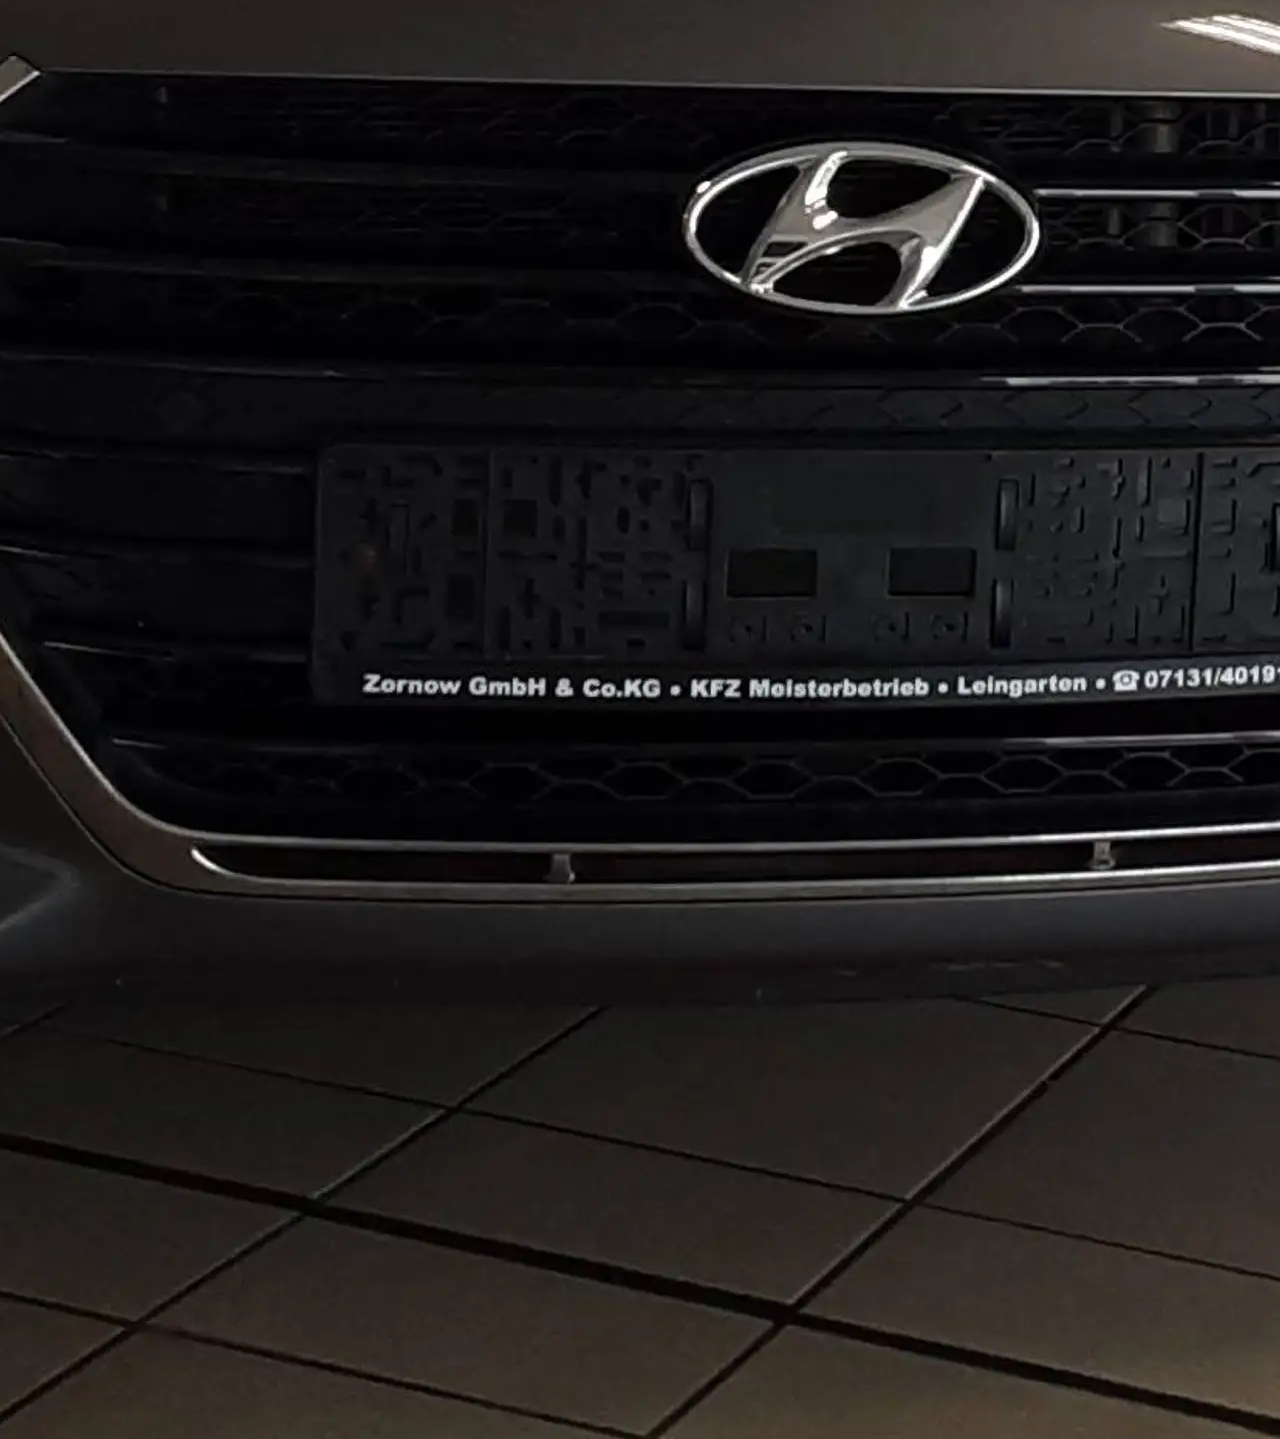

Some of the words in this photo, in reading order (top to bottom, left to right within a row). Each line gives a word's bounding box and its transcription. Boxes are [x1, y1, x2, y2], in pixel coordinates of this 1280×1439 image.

[361, 672, 463, 696] Zornow
[467, 675, 548, 698] GmbH
[553, 676, 575, 699] &
[581, 677, 662, 699] Co.KG
[689, 677, 743, 699] KFZ
[747, 675, 931, 699] Meisterbetrieb
[956, 672, 1089, 700] Leingarten
